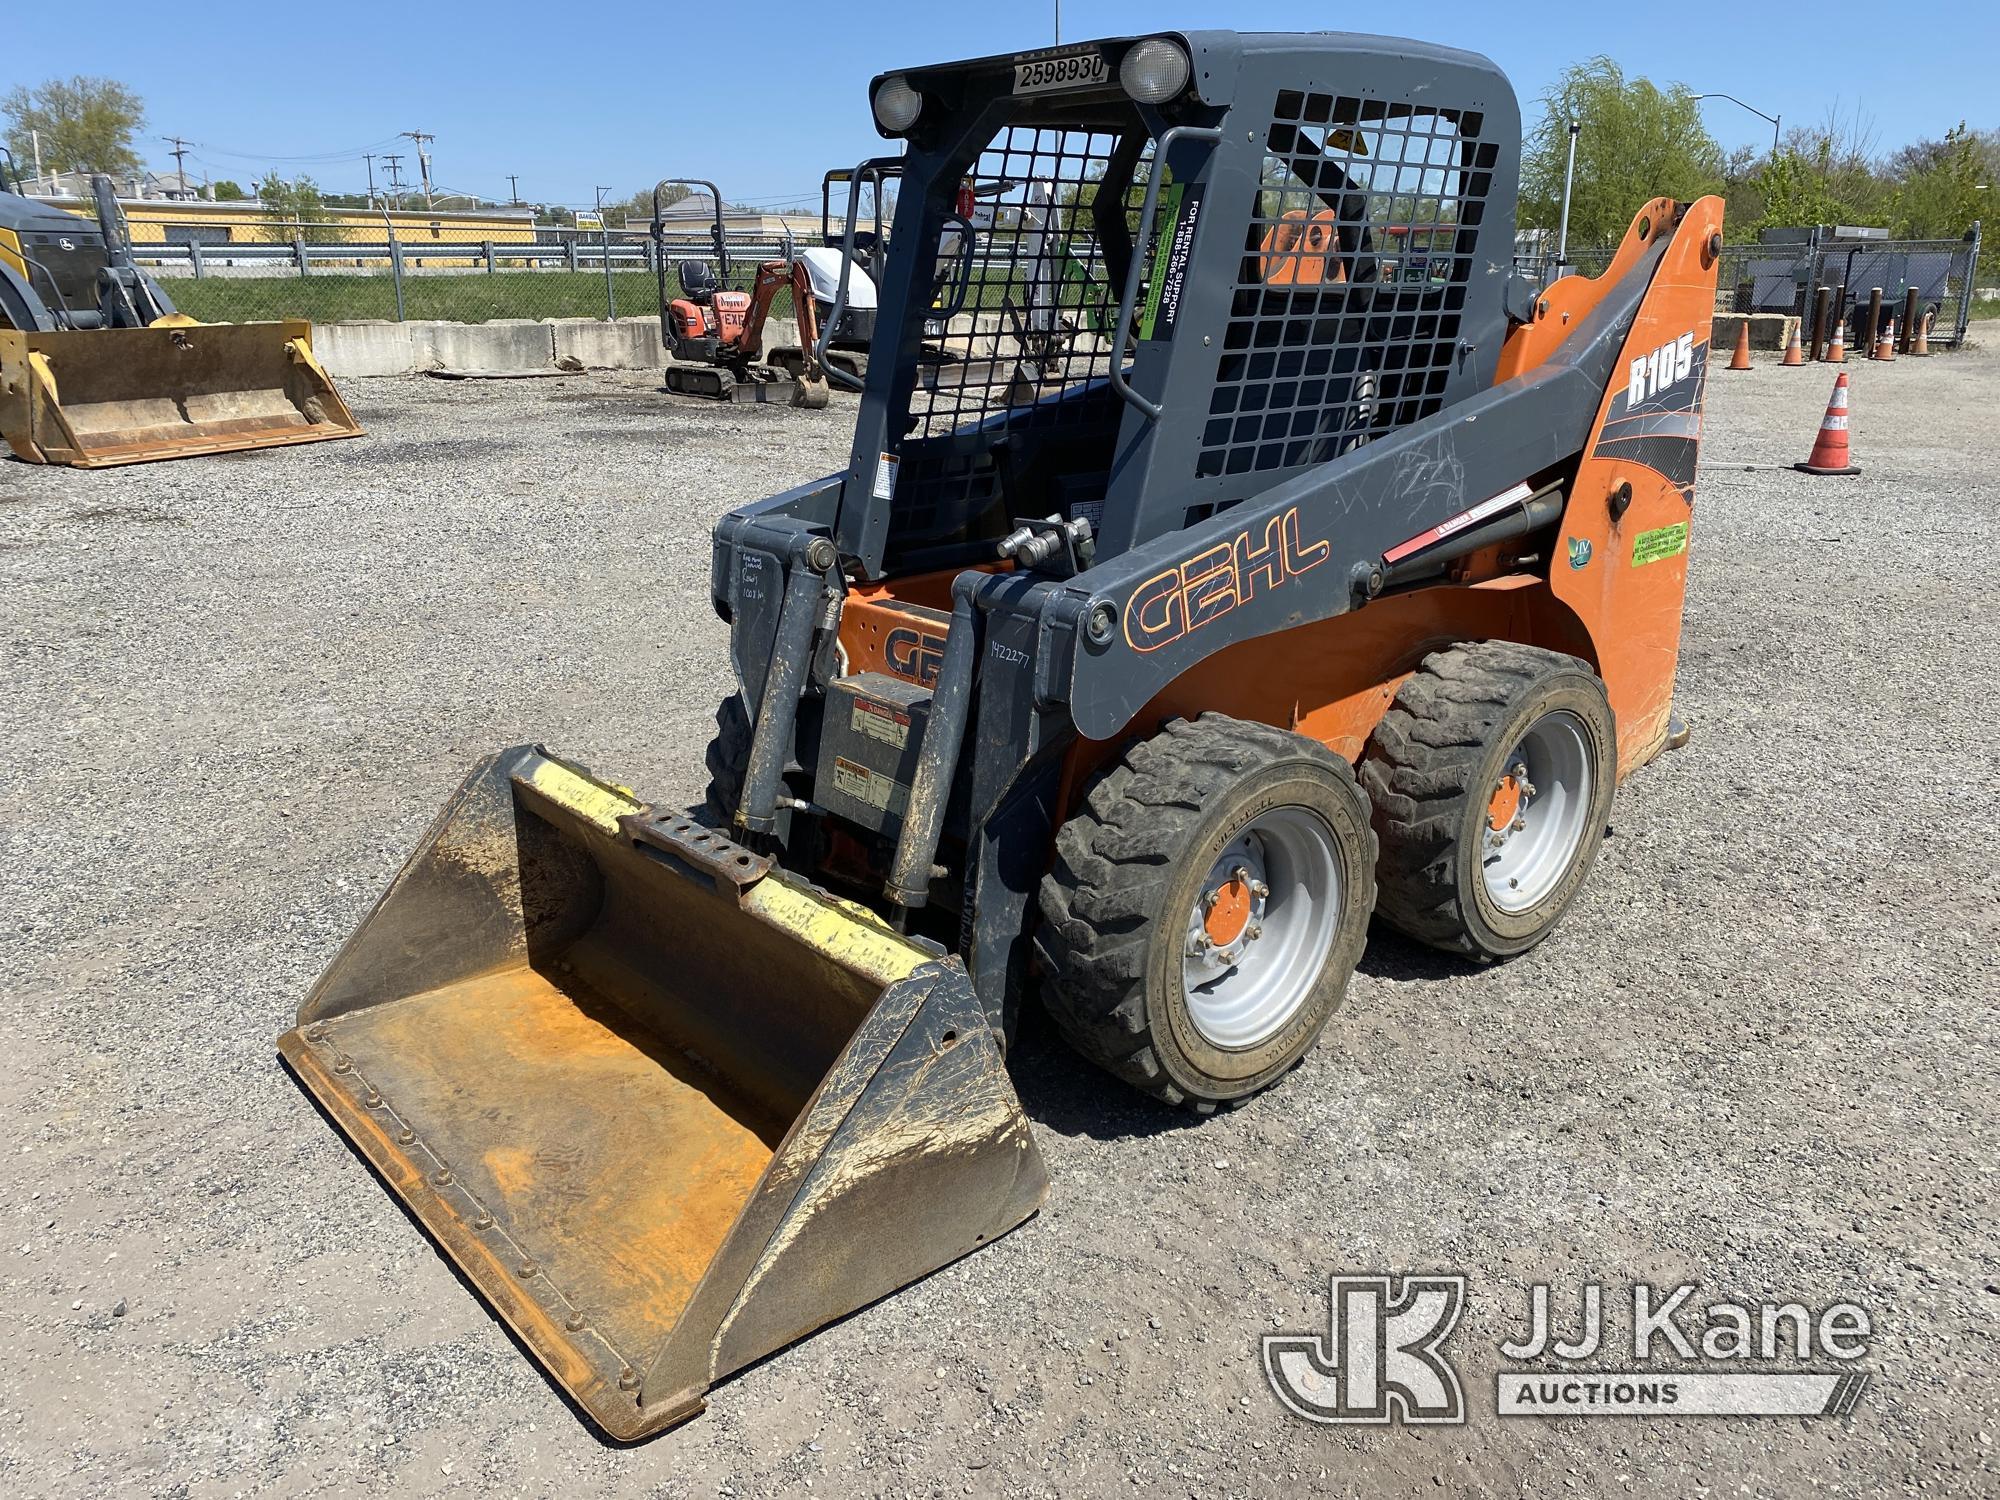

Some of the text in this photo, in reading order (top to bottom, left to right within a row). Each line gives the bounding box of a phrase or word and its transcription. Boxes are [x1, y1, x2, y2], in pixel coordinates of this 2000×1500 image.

[1020, 56, 1104, 87] 2598930
[1161, 220, 1187, 304] 1-888-266-7228
[1164, 199, 1199, 324] FOR RENTAL SUPPORT
[1627, 330, 1696, 410] R105
[1123, 506, 1330, 652] GEHL
[991, 640, 1029, 669] 1422277
